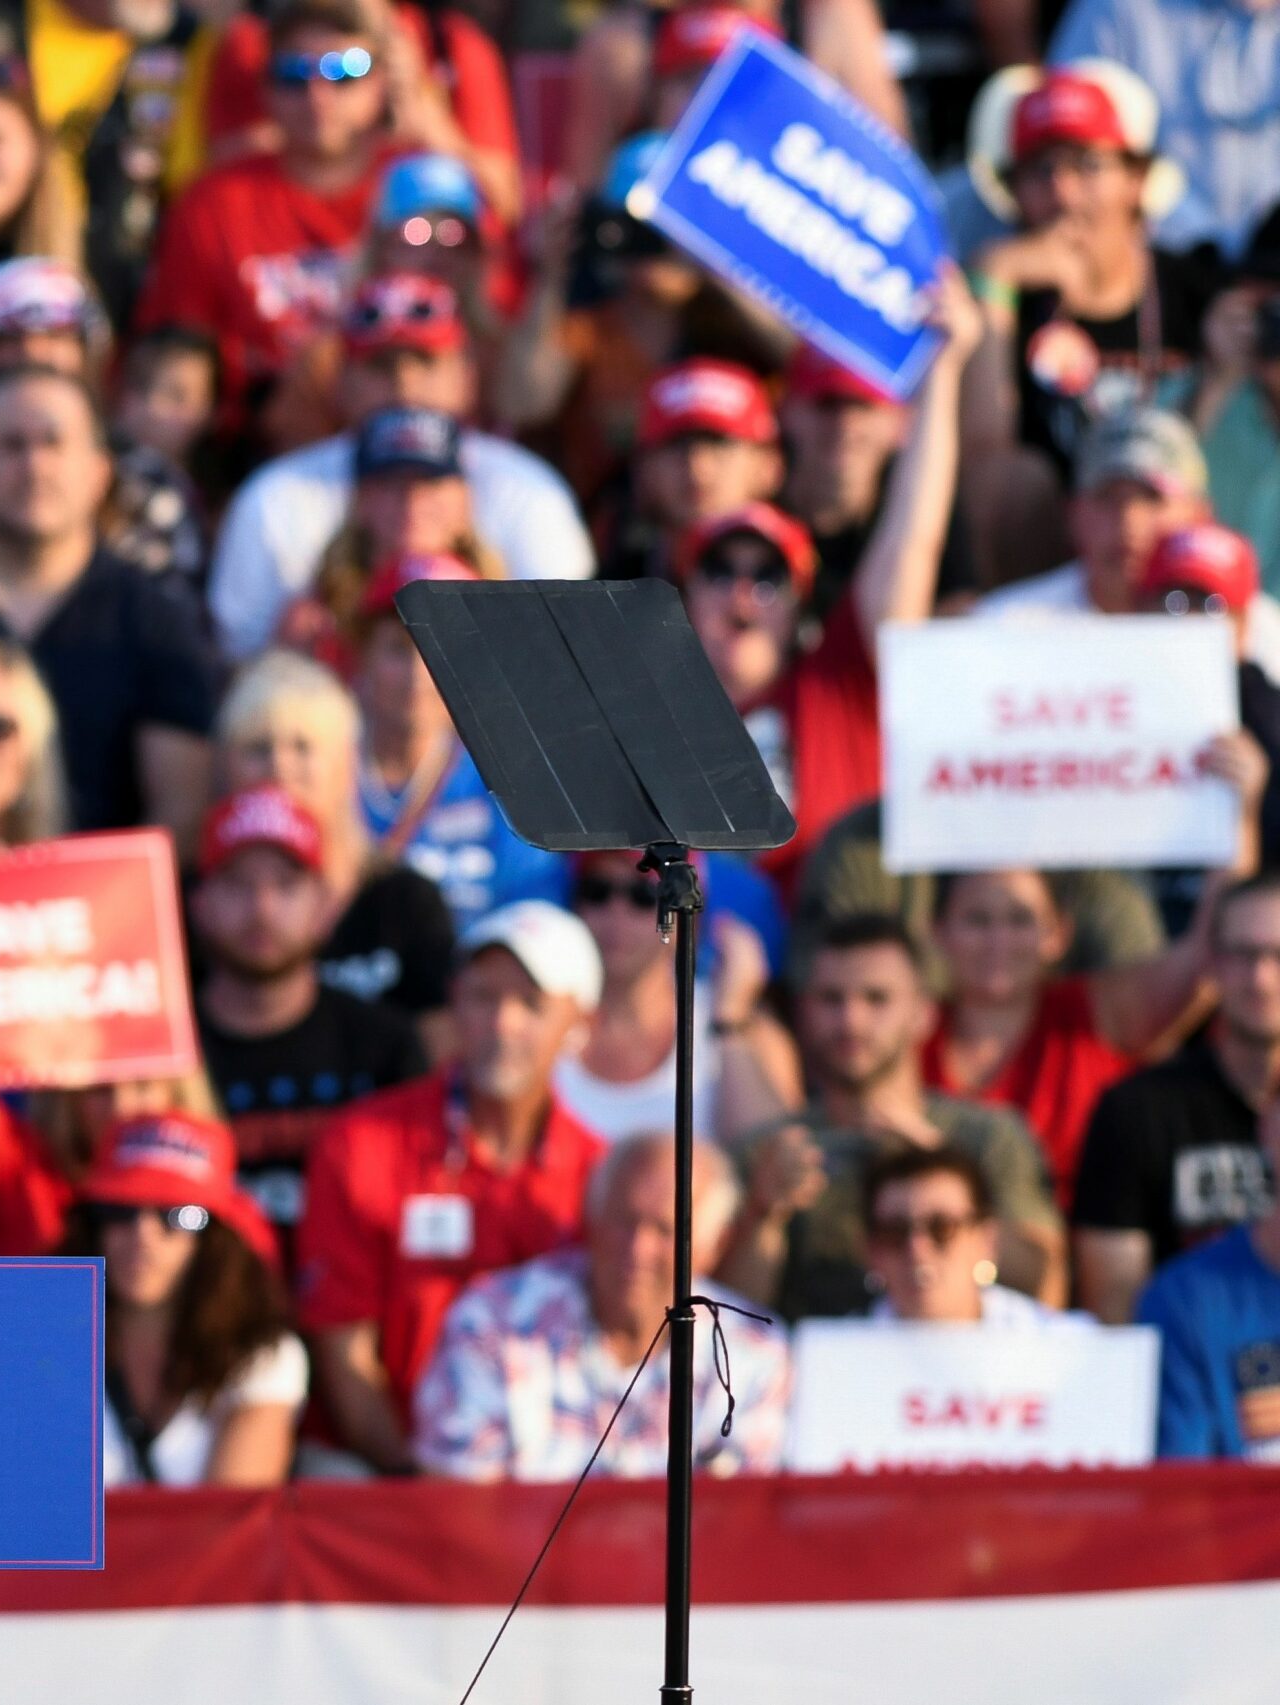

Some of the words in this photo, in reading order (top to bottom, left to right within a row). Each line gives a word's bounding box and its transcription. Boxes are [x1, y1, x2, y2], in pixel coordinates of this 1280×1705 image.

[772, 122, 916, 247] SAVE
[988, 688, 1136, 737] SAVE
[902, 1391, 1047, 1433] SAVE
